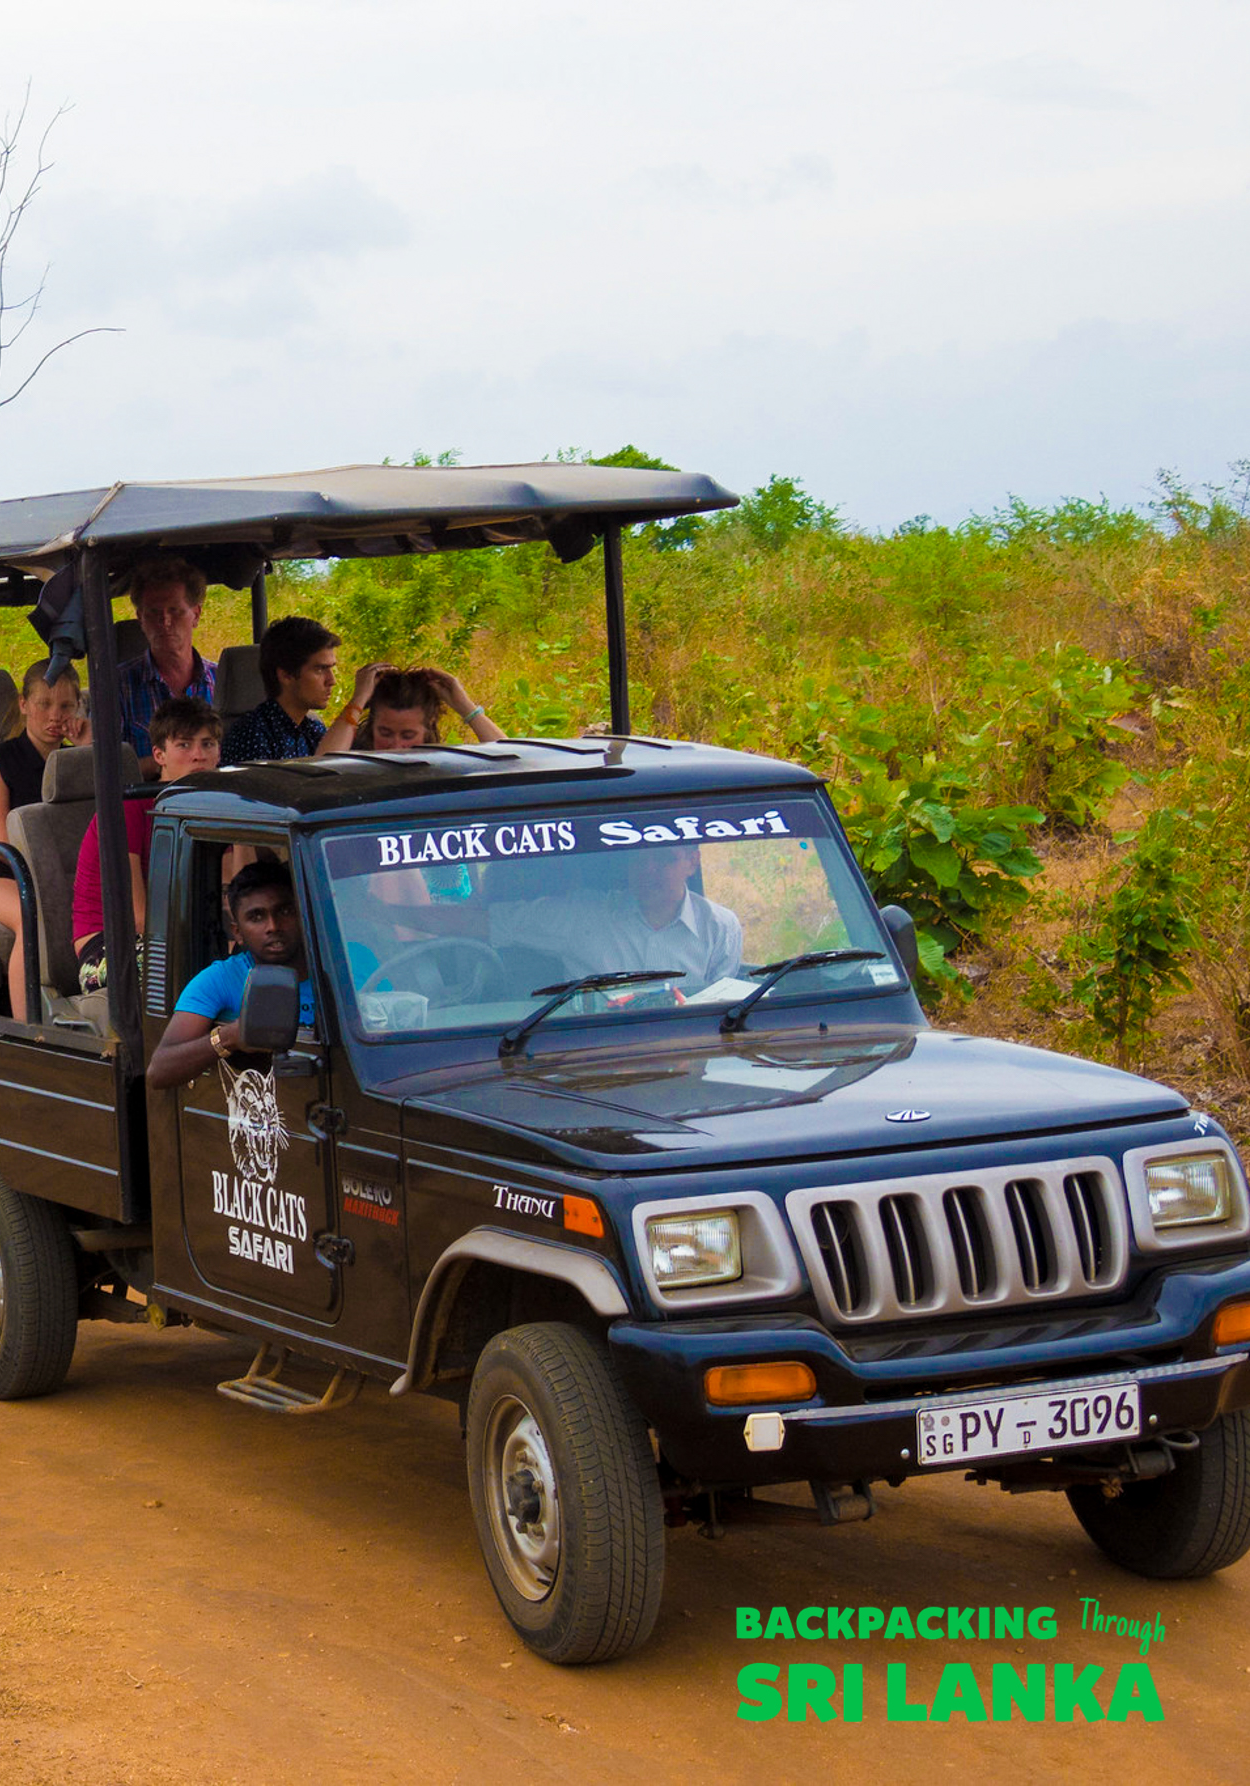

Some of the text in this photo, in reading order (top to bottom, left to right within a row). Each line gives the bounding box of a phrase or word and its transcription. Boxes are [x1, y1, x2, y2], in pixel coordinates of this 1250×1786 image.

[377, 811, 791, 867] BLACK CATS Safari
[211, 1170, 308, 1243] BLACK CATS
[342, 1176, 393, 1207] BOLERO
[343, 1196, 400, 1226] MAXITRUCK
[228, 1226, 296, 1275] SAFARI
[926, 1433, 954, 1457] SG
[959, 1407, 1005, 1452] PY
[1047, 1391, 1135, 1440] 3096
